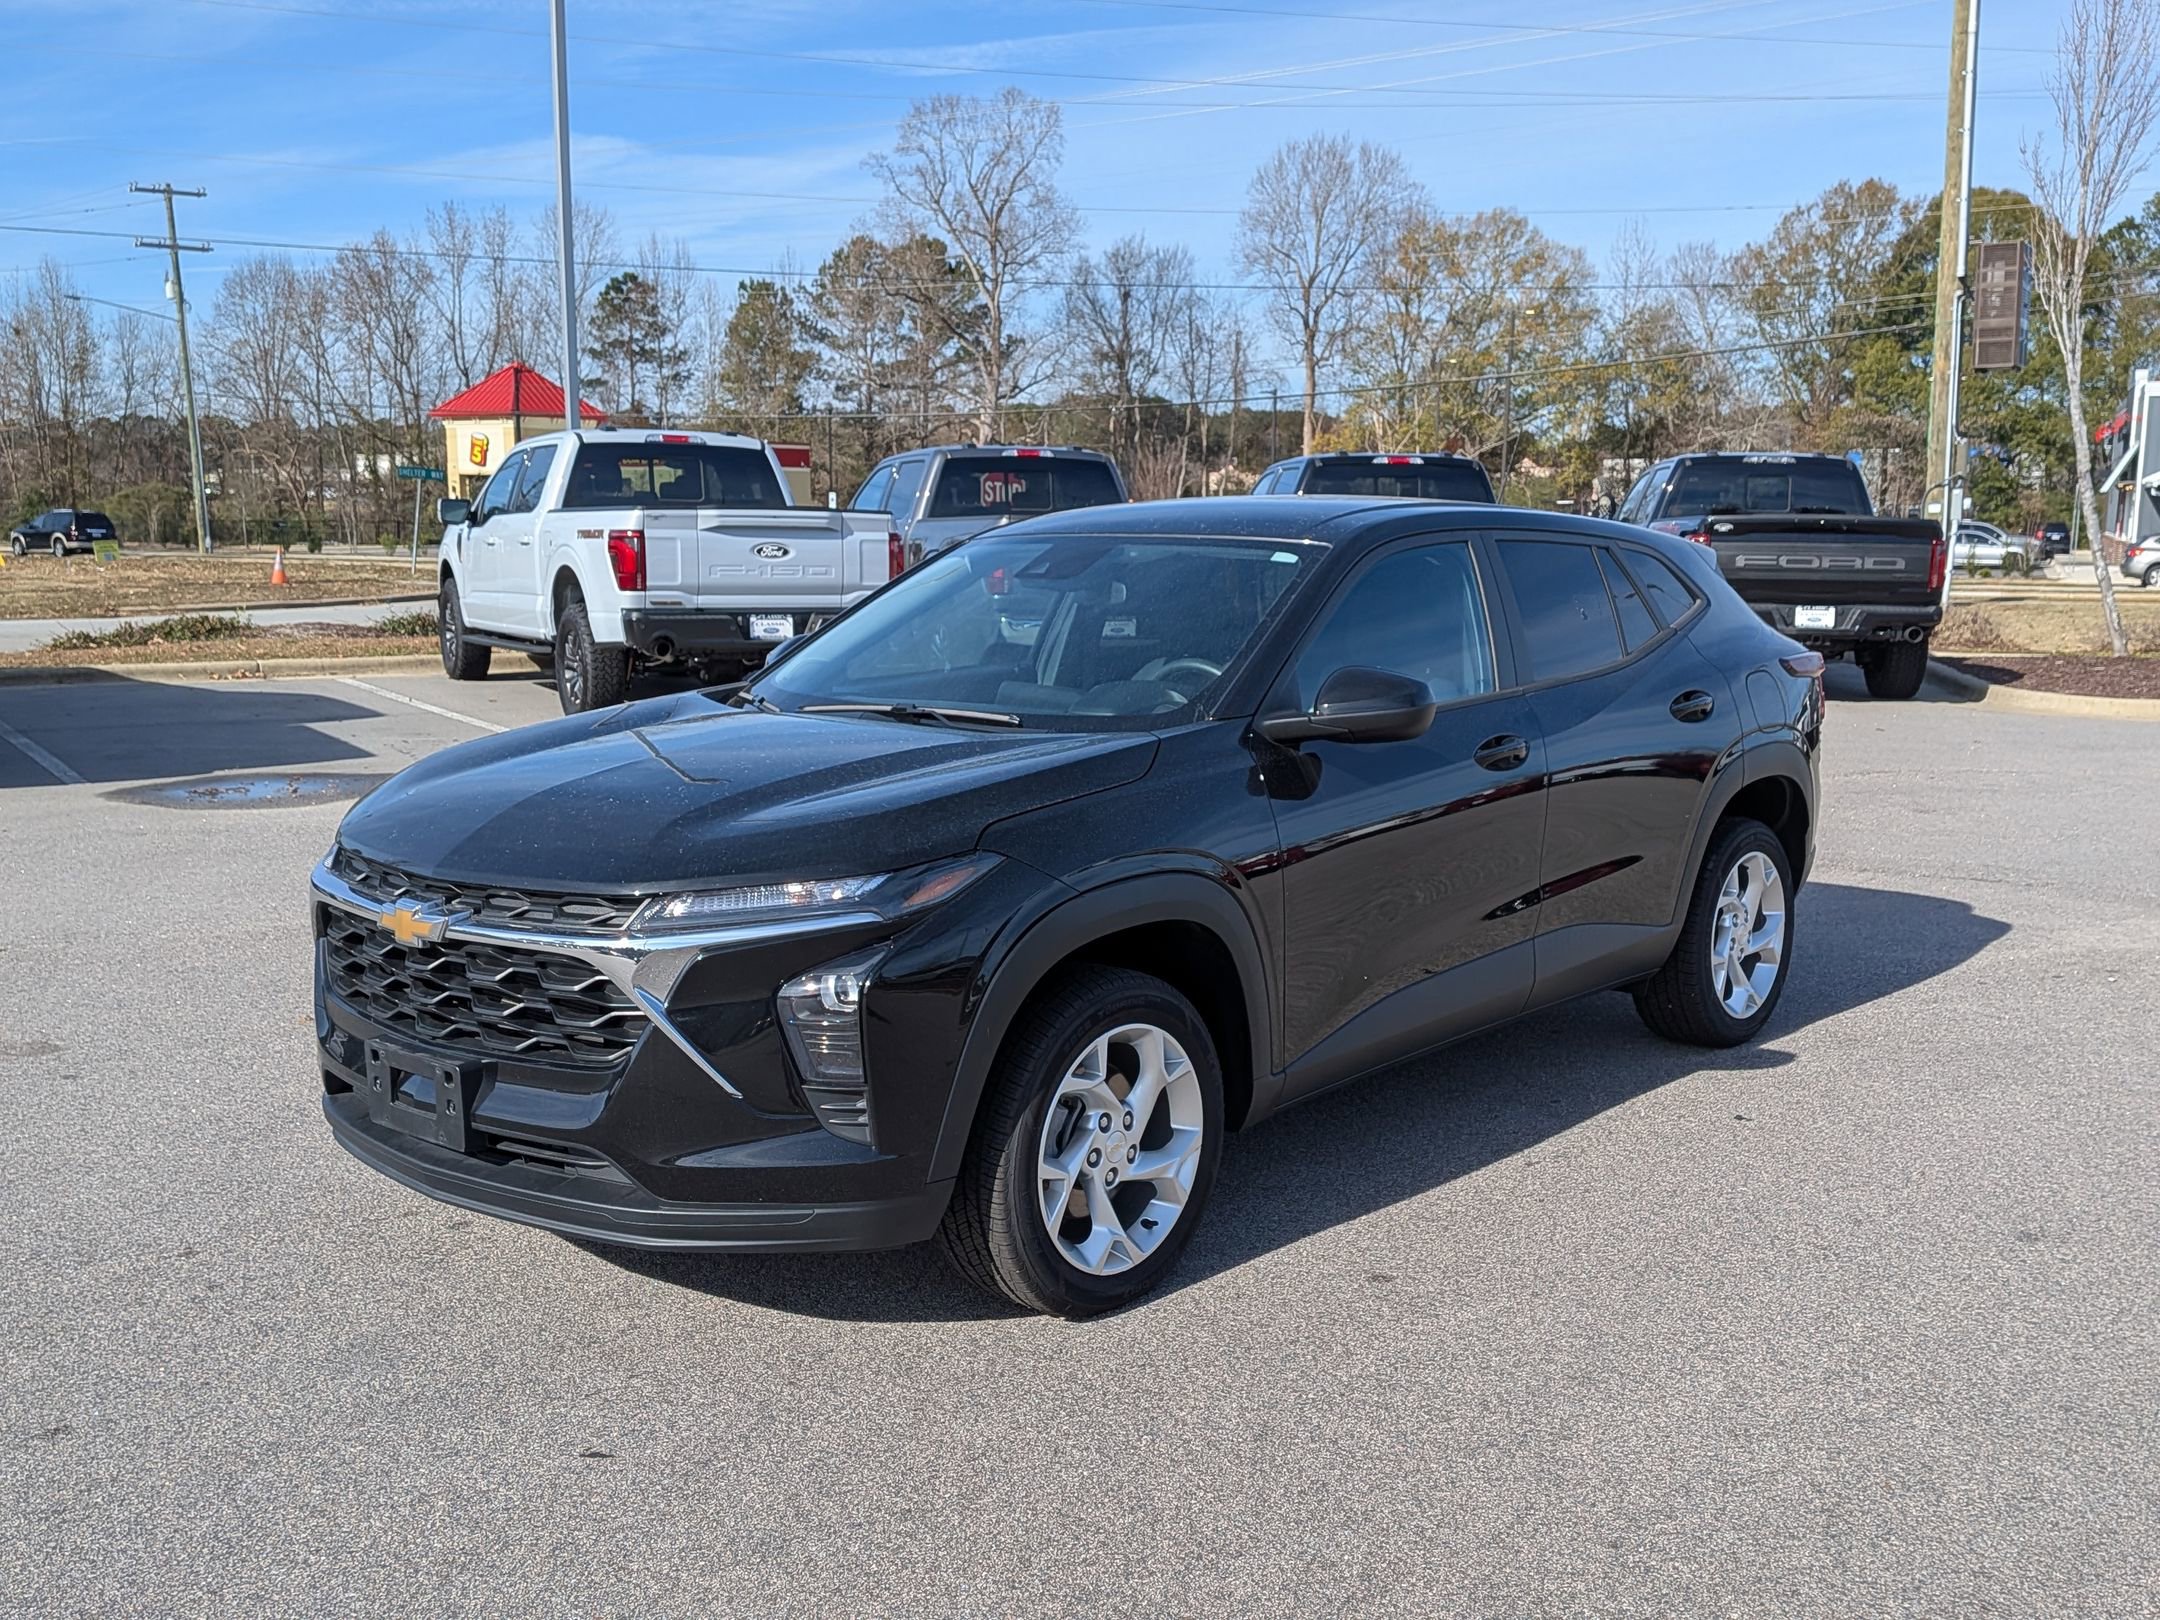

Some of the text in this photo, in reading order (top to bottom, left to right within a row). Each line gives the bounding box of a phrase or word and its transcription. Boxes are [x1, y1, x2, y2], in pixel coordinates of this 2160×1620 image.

[760, 545, 784, 558] Ford
[1735, 554, 1906, 570] FORD
[708, 564, 835, 578] F-150
